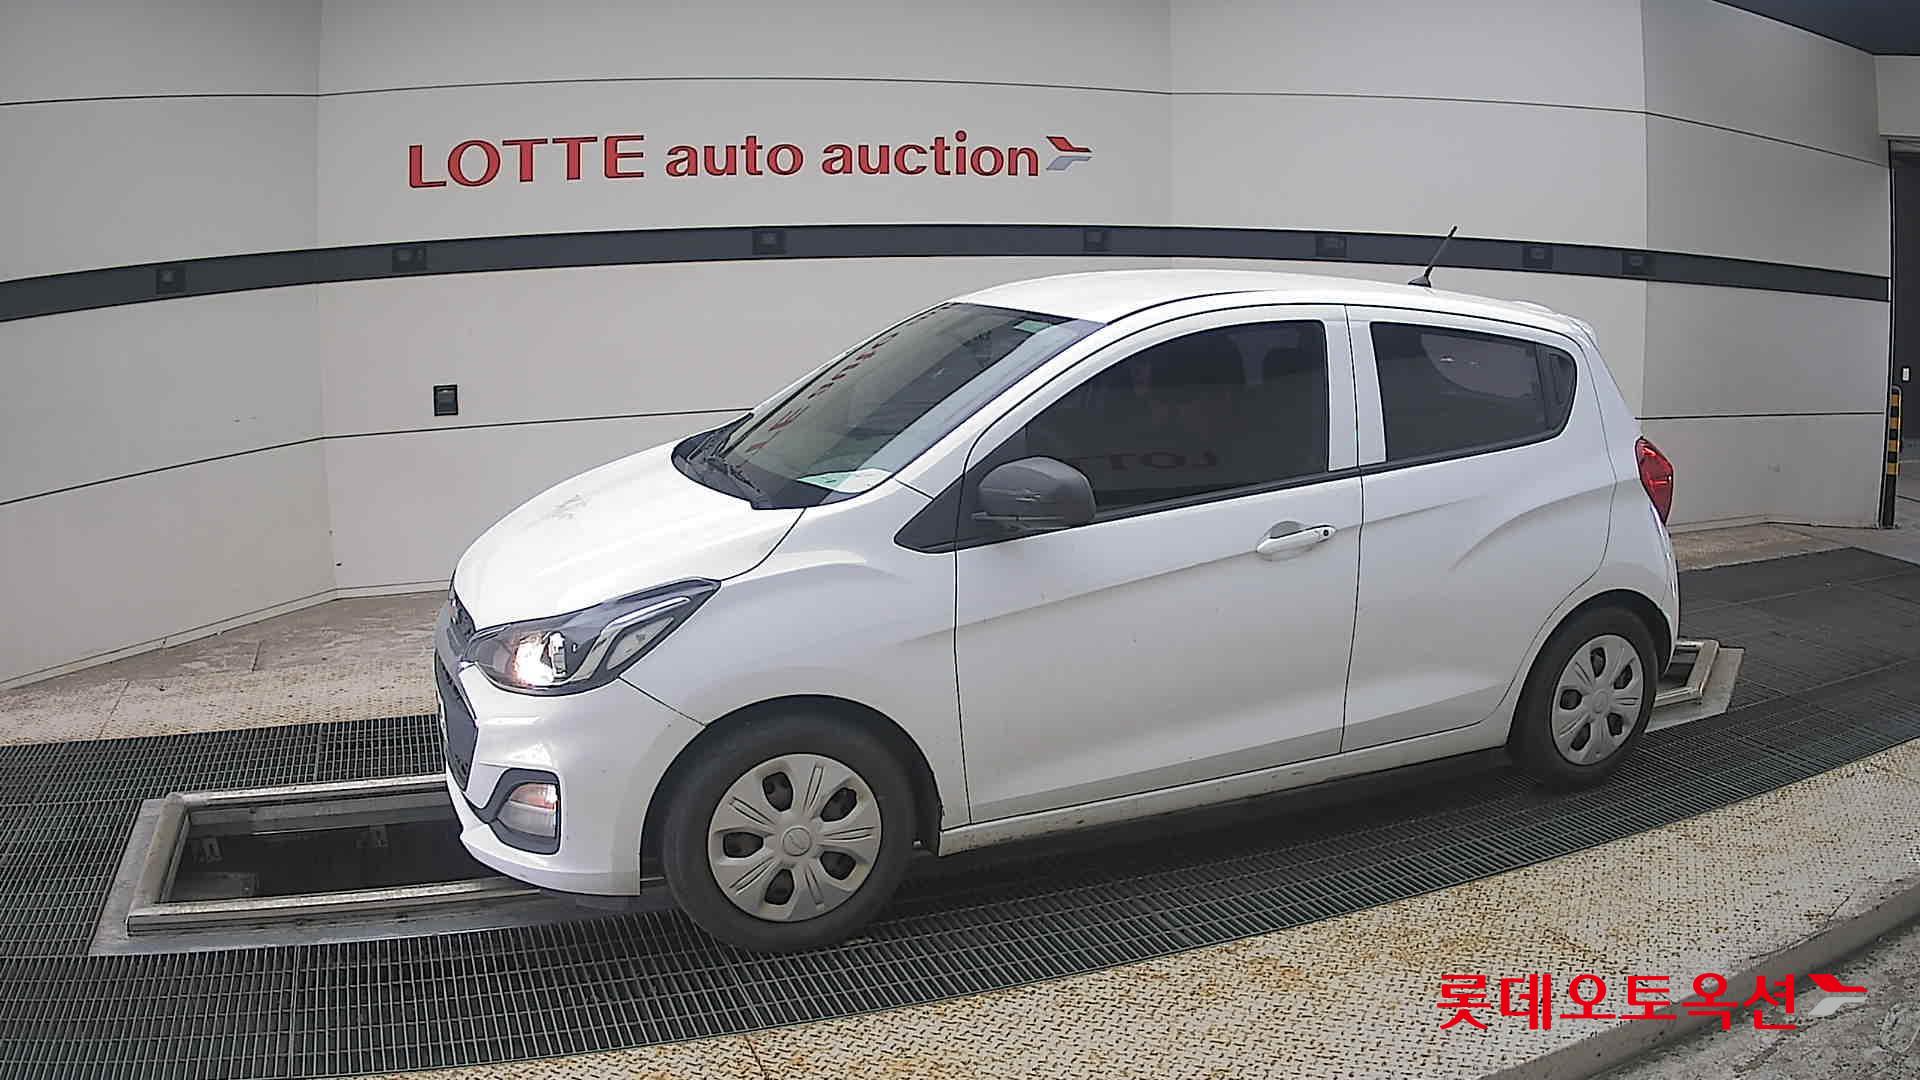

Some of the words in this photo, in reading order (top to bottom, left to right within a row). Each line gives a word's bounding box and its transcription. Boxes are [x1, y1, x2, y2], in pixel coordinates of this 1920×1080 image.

[408, 134, 645, 188] LOTTE
[665, 135, 805, 176] auto
[821, 130, 1040, 176] auction
